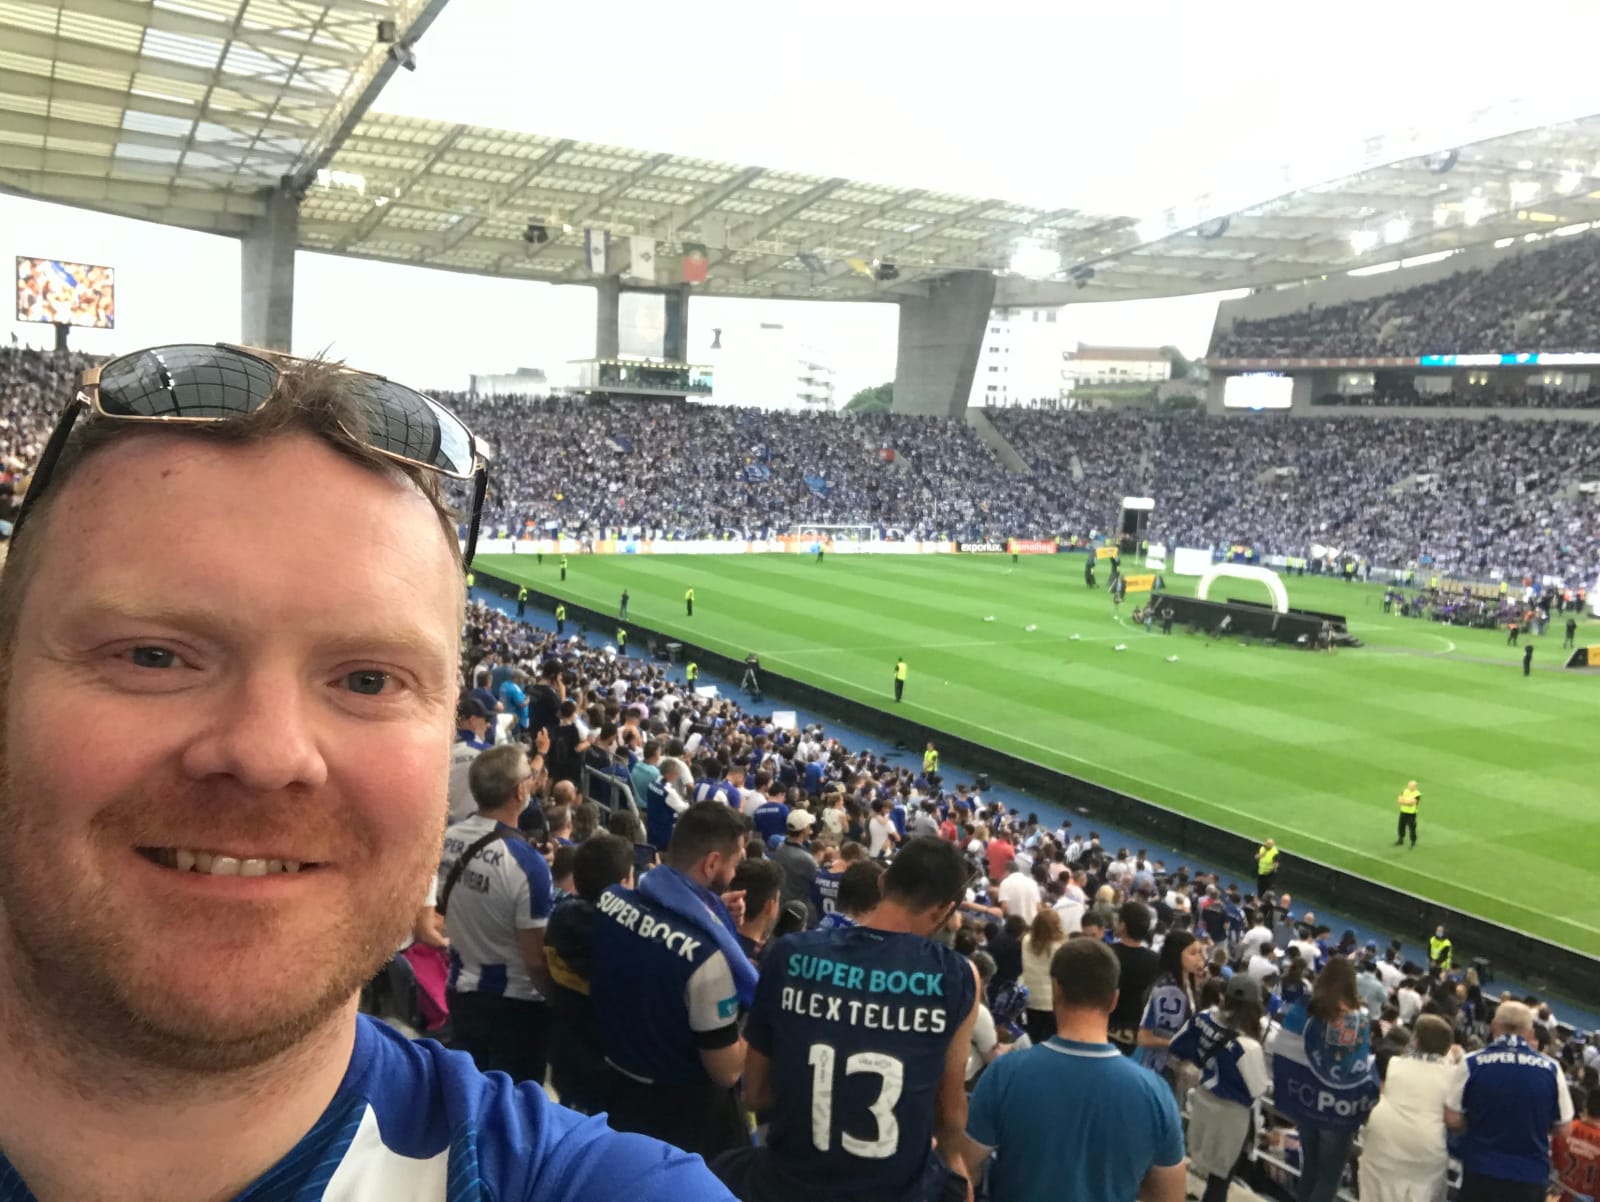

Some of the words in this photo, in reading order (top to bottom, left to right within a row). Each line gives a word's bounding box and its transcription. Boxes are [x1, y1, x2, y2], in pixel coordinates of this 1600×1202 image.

[596, 891, 640, 931] SUPER
[638, 914, 701, 962] BOCK
[787, 953, 865, 991] SUPER
[868, 969, 945, 997] BOCK
[781, 986, 843, 1022] ALEX
[848, 1000, 947, 1034] TELLES
[1475, 1052, 1516, 1066] SUPER
[1517, 1054, 1552, 1070] BOCK
[808, 1043, 904, 1158] 13
